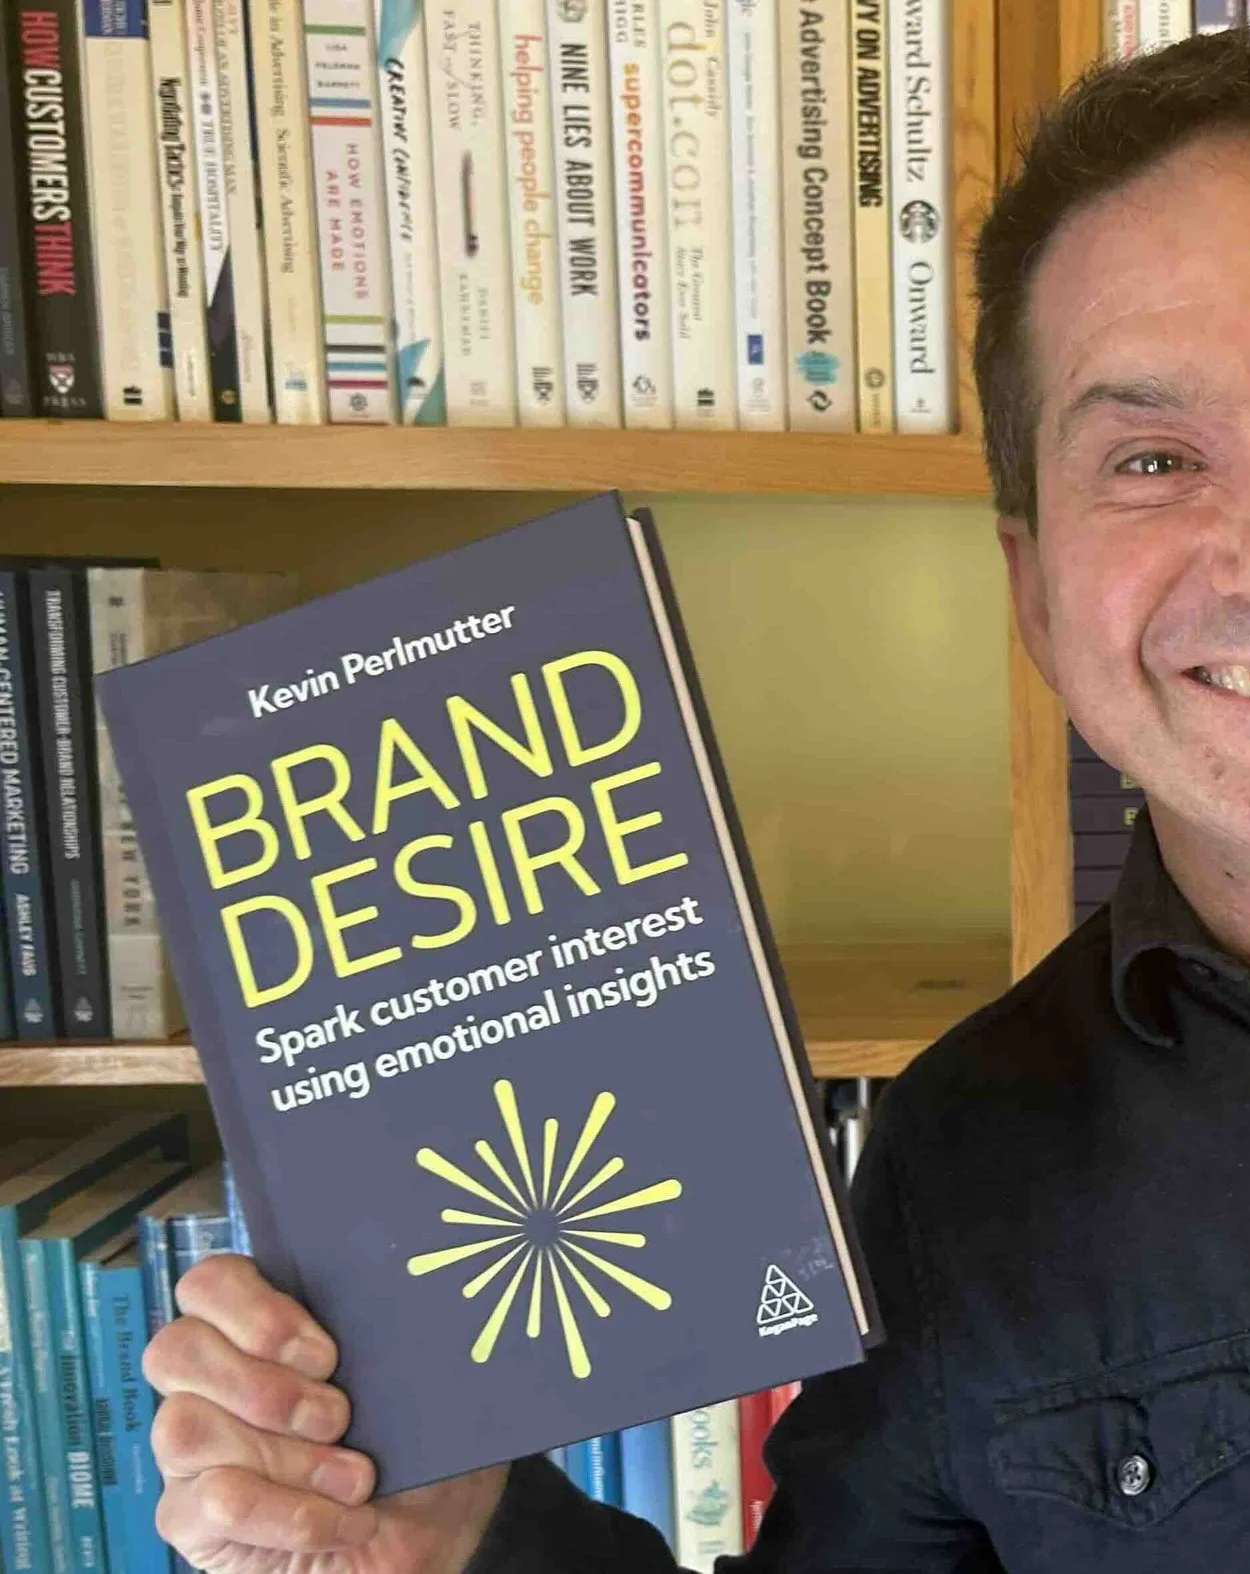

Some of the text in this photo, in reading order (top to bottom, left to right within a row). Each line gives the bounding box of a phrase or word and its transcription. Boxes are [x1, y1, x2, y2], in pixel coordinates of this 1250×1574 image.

[159, 78, 184, 143] Negotiating
[268, 36, 287, 117] Advertising
[384, 57, 409, 143] CREATIVE
[441, 10, 461, 132] FAST SLOW
[857, 29, 883, 208] ON ADVERTISING
[20, 11, 76, 297] HOW CUSTOMERS THINK
[325, 171, 345, 273] ARE MADE
[345, 144, 369, 300] HOW EMOTIONS
[510, 34, 552, 305] helping people change
[559, 43, 598, 298] NINE LIES ABOUT WORK
[621, 63, 652, 342] supercommunicators
[797, 10, 832, 345] Advertising Concept Book
[904, 75, 936, 375] Schultz Onward
[277, 195, 296, 275] Advertising
[45, 589, 67, 675] TRANSFORMING
[58, 779, 80, 860] RELATIONSHIPS
[248, 604, 516, 718] Kevin Perlmutter
[2, 769, 30, 875] MARKETING
[186, 650, 643, 890] BRAND
[15, 893, 35, 941] ASHLEY
[123, 877, 141, 927] YORK
[220, 761, 689, 1008] DESIRE
[255, 896, 704, 1068] Spark customer interest
[271, 949, 716, 1111] using emotional insights
[60, 1354, 95, 1510] Innovation BIOME
[111, 1294, 141, 1433] The Brand Book
[691, 1404, 719, 1470] ooks
